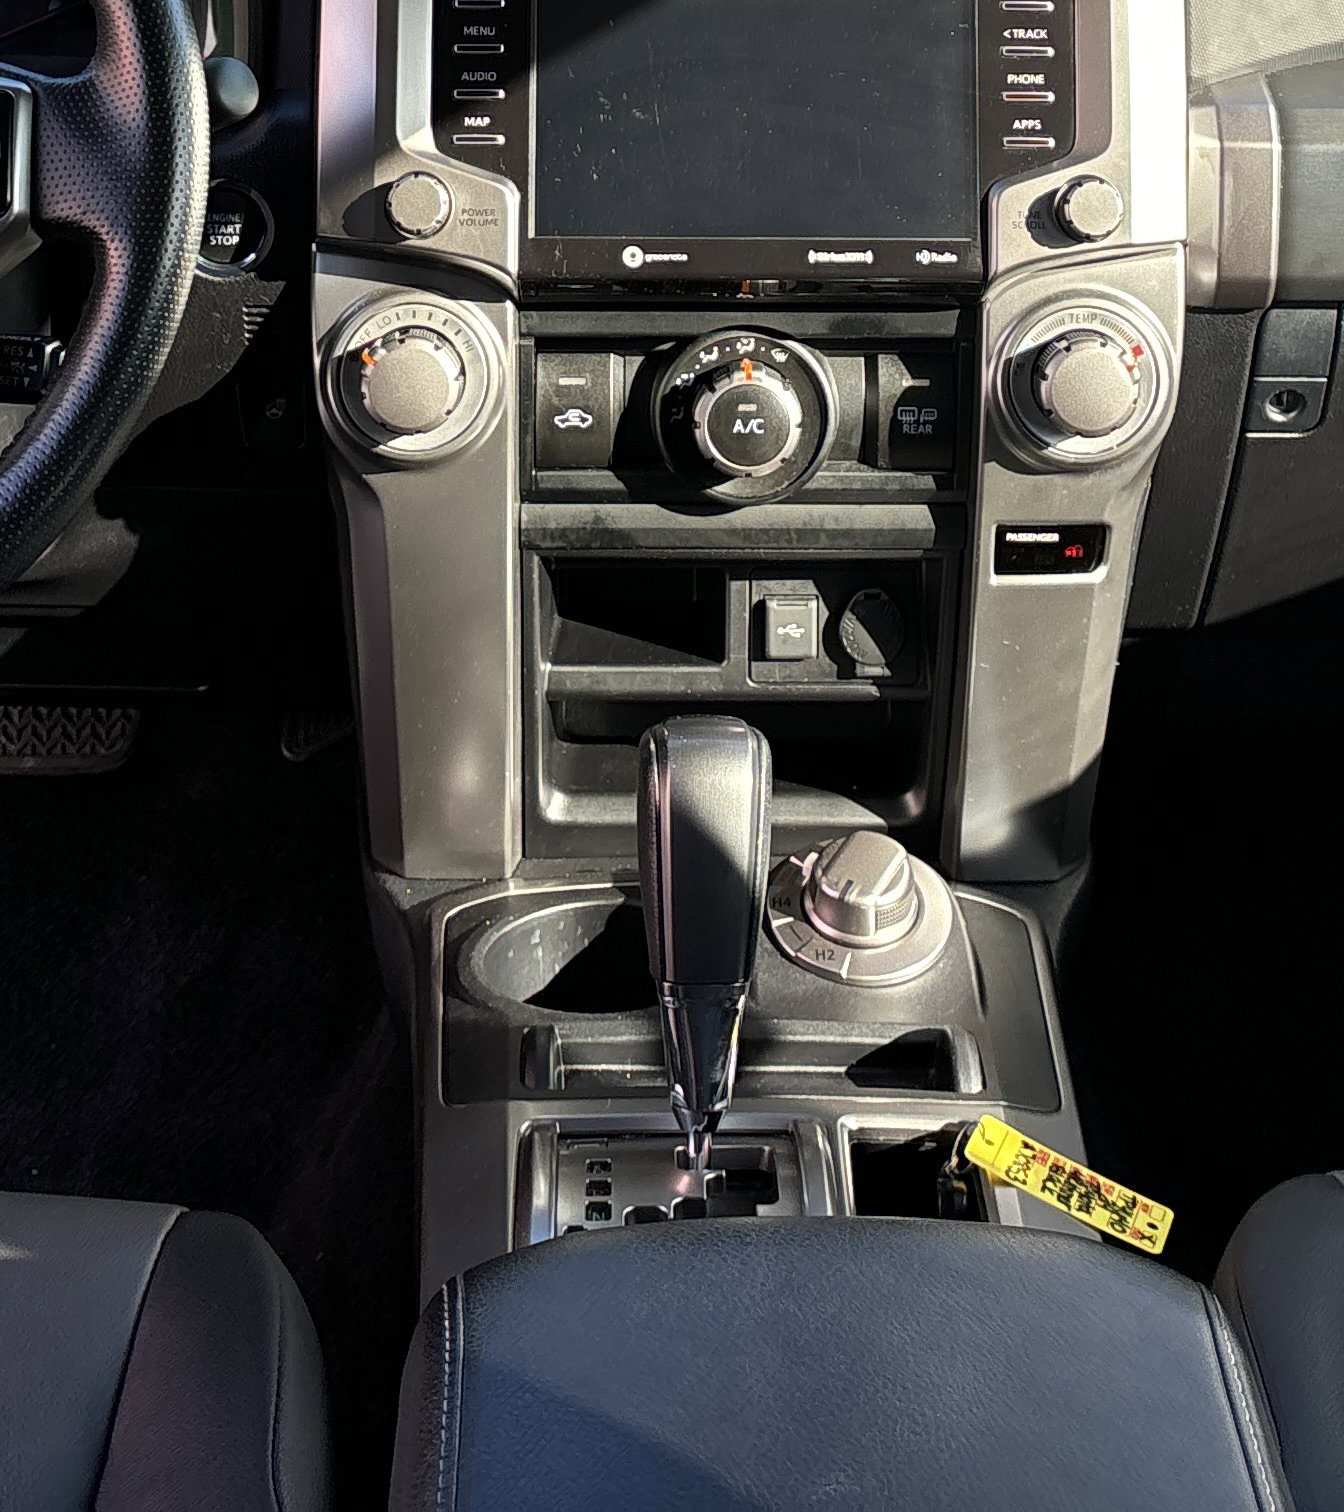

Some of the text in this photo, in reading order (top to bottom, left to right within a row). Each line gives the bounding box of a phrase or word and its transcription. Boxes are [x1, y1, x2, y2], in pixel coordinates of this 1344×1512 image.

[463, 26, 496, 35] MENU
[1012, 29, 1048, 39] TRACK
[461, 71, 497, 81] AUDIO
[1007, 74, 1045, 85] PHONE
[464, 117, 491, 127] MAP
[1013, 119, 1042, 130] APPS
[207, 213, 241, 223] ENGINE
[461, 208, 496, 218] POWER
[1017, 211, 1042, 221] TUNE
[459, 218, 499, 227] VOLUME
[1012, 220, 1047, 230] SCROLL
[207, 224, 243, 234] START
[209, 235, 240, 246] STOP
[376, 315, 392, 329] LO
[1068, 313, 1098, 326] TEMP
[3, 345, 24, 357] RES
[462, 339, 475, 353] HI
[0, 375, 19, 386] SET
[732, 417, 765, 435] A/C
[902, 423, 933, 435] REAR
[1006, 532, 1059, 543] PASSENGER
[771, 896, 792, 908] H4
[814, 949, 835, 961] H2
